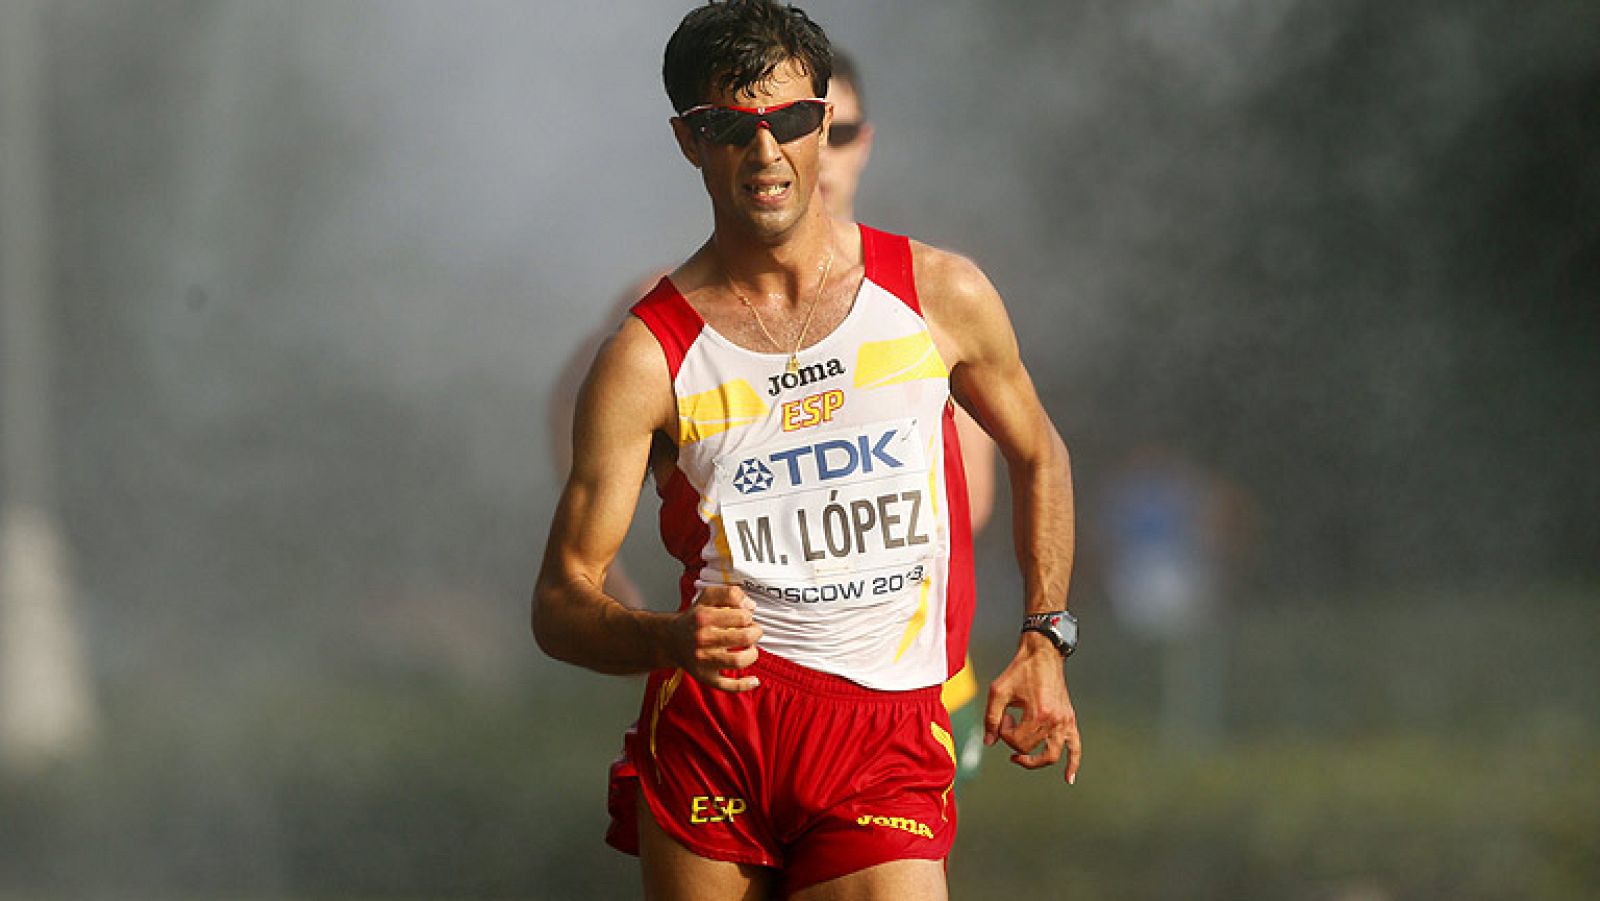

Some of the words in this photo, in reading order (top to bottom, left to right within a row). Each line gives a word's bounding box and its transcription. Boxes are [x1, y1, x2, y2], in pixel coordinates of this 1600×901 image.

[768, 358, 845, 396] Joma
[781, 389, 845, 432] ESP
[770, 429, 904, 486] TDK
[735, 516, 788, 566] M.
[797, 489, 929, 562] LÓPEZ
[691, 796, 746, 823] ESP
